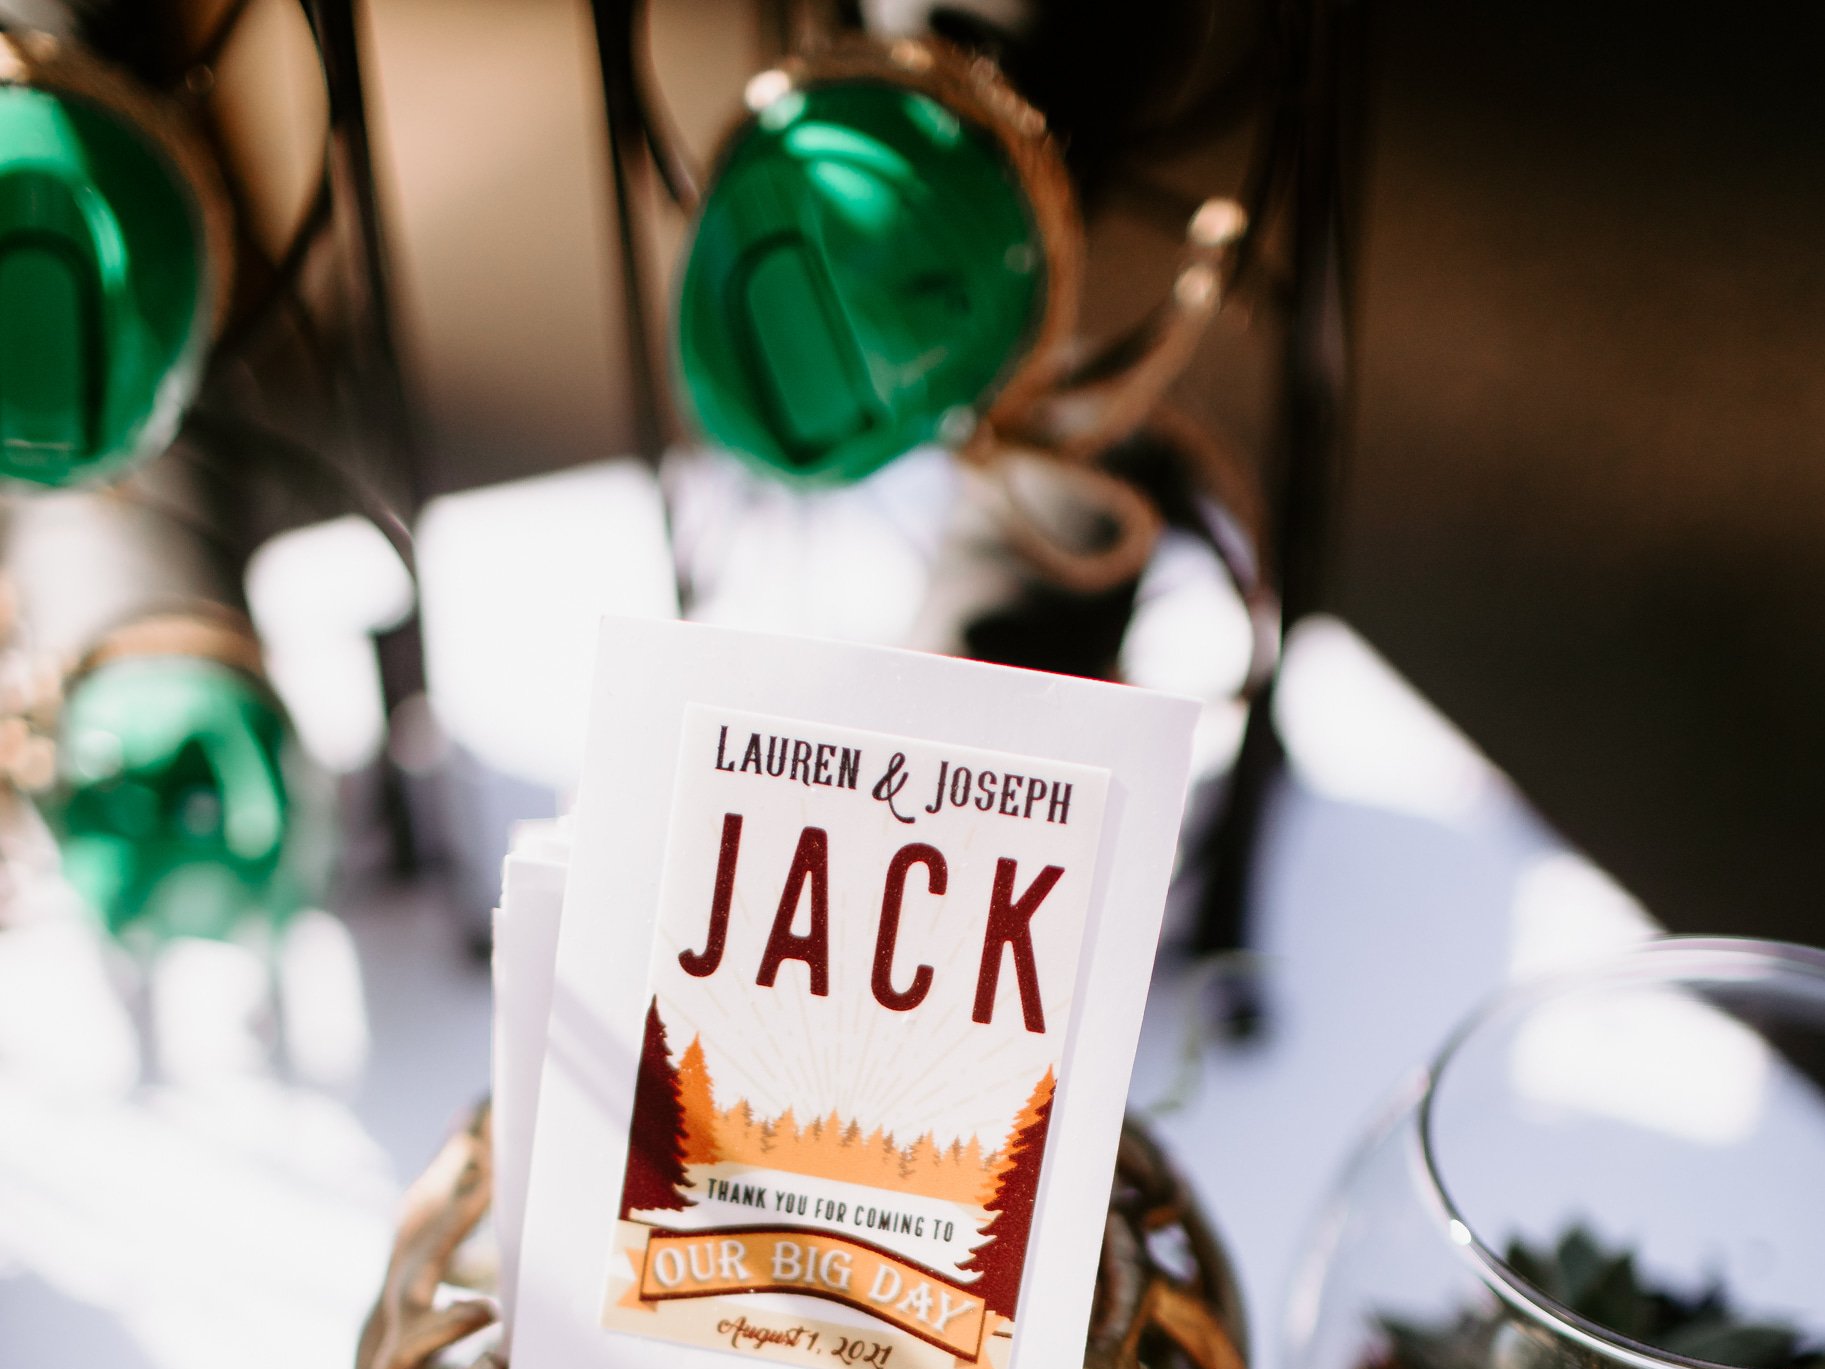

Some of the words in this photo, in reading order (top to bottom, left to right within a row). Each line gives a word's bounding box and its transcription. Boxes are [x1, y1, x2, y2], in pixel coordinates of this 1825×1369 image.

[714, 725, 862, 790] LAUREN
[871, 752, 916, 824] &
[925, 761, 1074, 825] JOSEPH
[677, 812, 1066, 1034] JACK
[707, 1178, 767, 1210] THANK
[775, 1189, 808, 1217] YOU
[815, 1198, 847, 1225] FOR
[854, 1205, 924, 1238] COMING
[934, 1219, 955, 1243] TO
[653, 1240, 748, 1288] OUR
[770, 1241, 853, 1291] BIG
[869, 1262, 977, 1331] DAY
[717, 1316, 806, 1350] August
